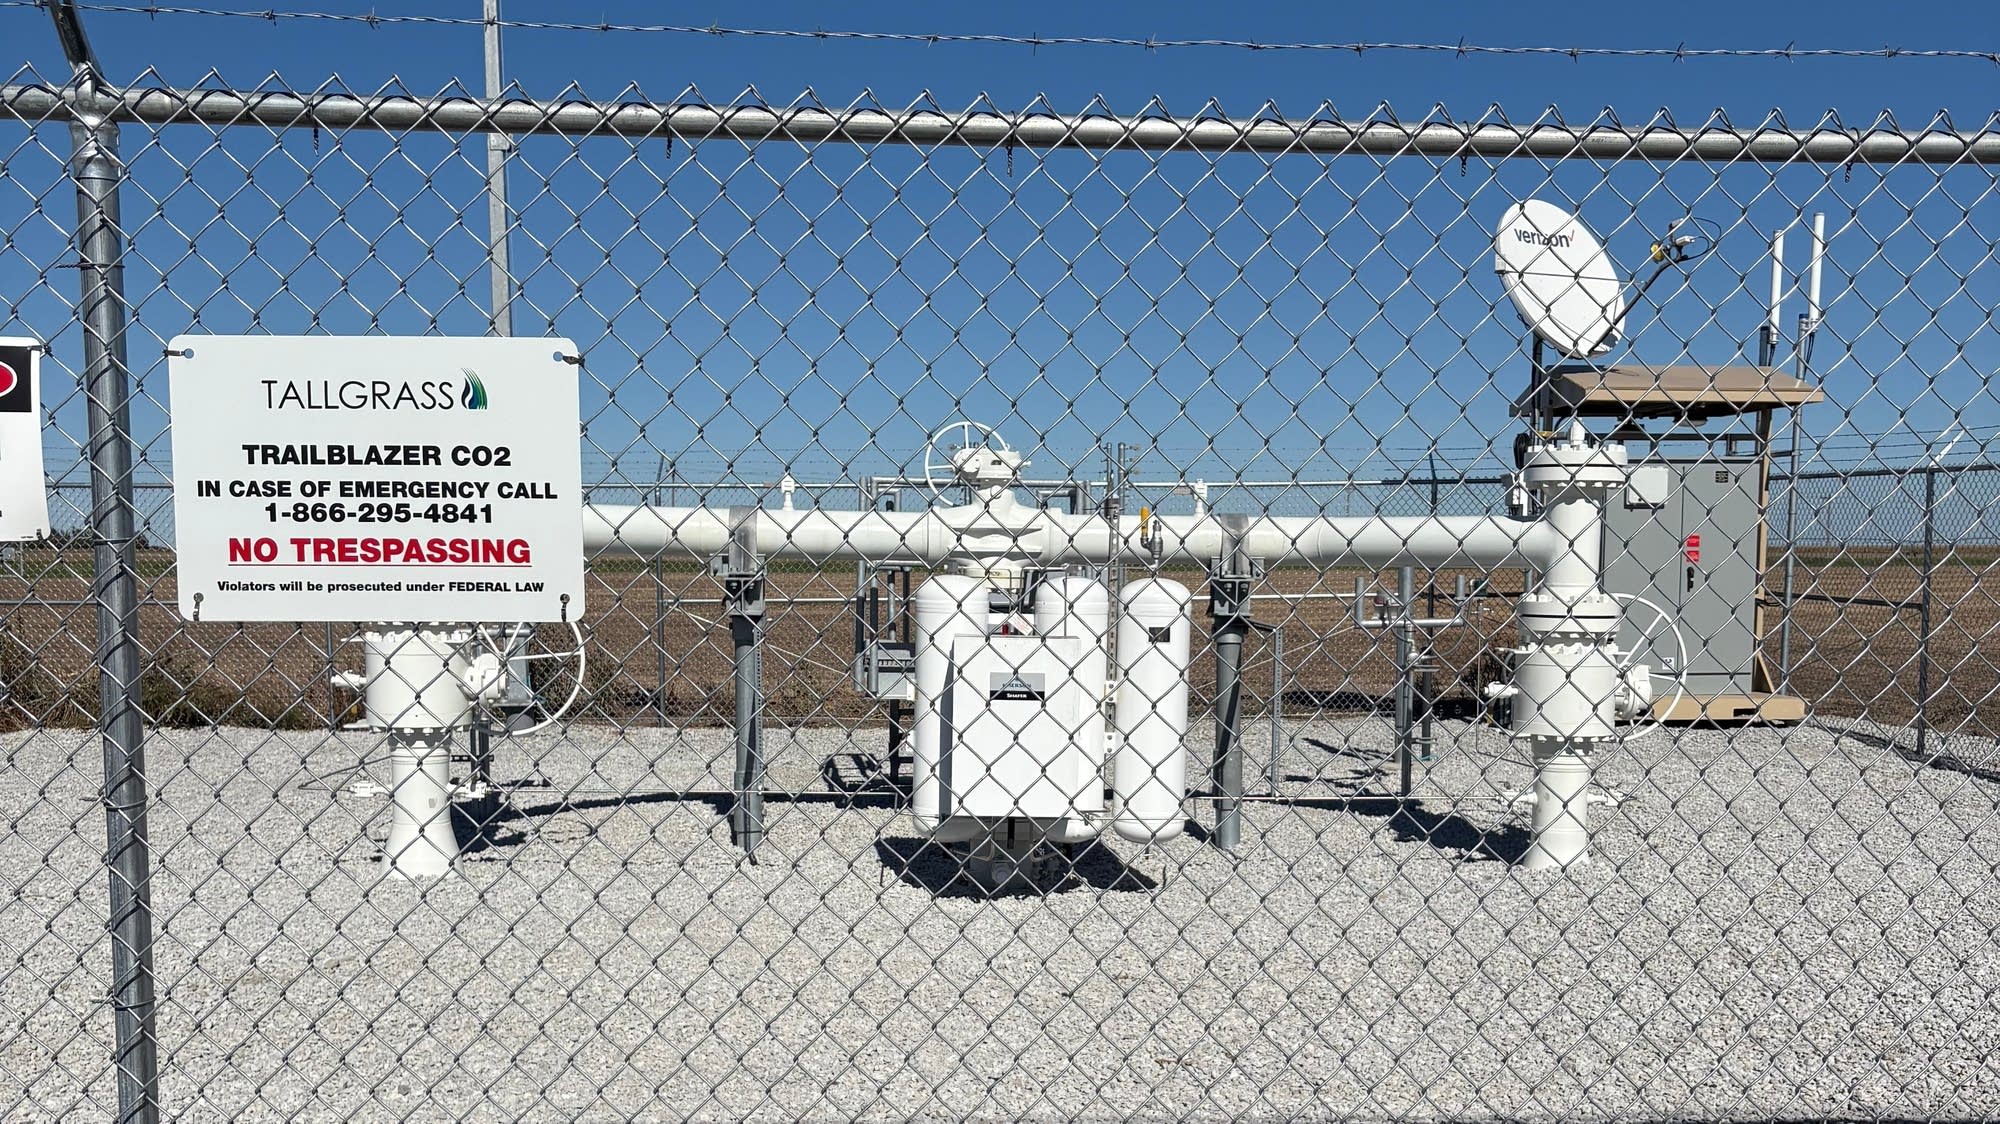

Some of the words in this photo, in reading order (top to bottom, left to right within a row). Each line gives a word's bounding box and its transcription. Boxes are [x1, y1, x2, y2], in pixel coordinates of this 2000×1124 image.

[1514, 228, 1570, 247] verizon
[262, 379, 454, 410] TALLGRASS
[242, 444, 441, 466] TRAILBLAZER
[451, 445, 511, 467] CO2
[197, 480, 220, 498] IN
[229, 480, 291, 498] CASE
[299, 480, 331, 498] OF
[340, 480, 489, 499] EMERGENCY
[498, 481, 558, 500] CALL
[265, 502, 493, 524] 1-866-295-4841
[229, 537, 278, 562] NO
[290, 538, 531, 563] TRESPASSING
[217, 580, 275, 592] Violators
[280, 581, 302, 592] will
[307, 581, 323, 592] be
[327, 581, 402, 594] prosecuted
[406, 582, 445, 592] under
[449, 582, 511, 592] FEDERAL
[515, 582, 544, 593] LAW
